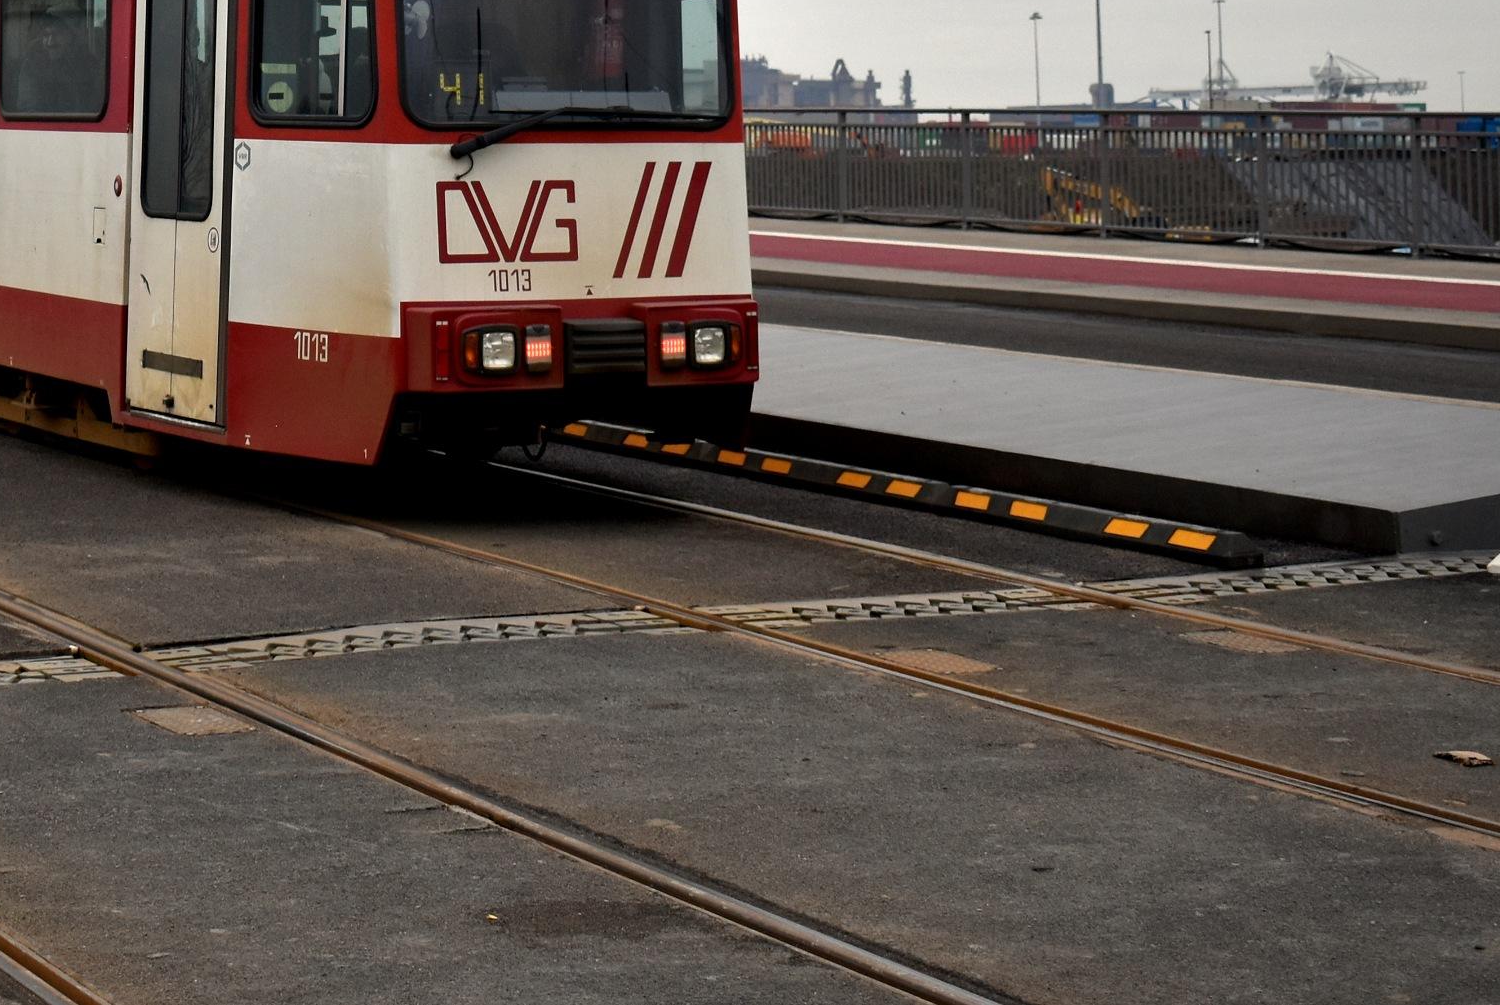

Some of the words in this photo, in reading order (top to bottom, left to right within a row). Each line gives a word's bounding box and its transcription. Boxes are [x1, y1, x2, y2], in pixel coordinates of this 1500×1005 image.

[436, 179, 579, 264] DVG
[488, 268, 532, 293] 1013
[293, 330, 329, 363] 1013
